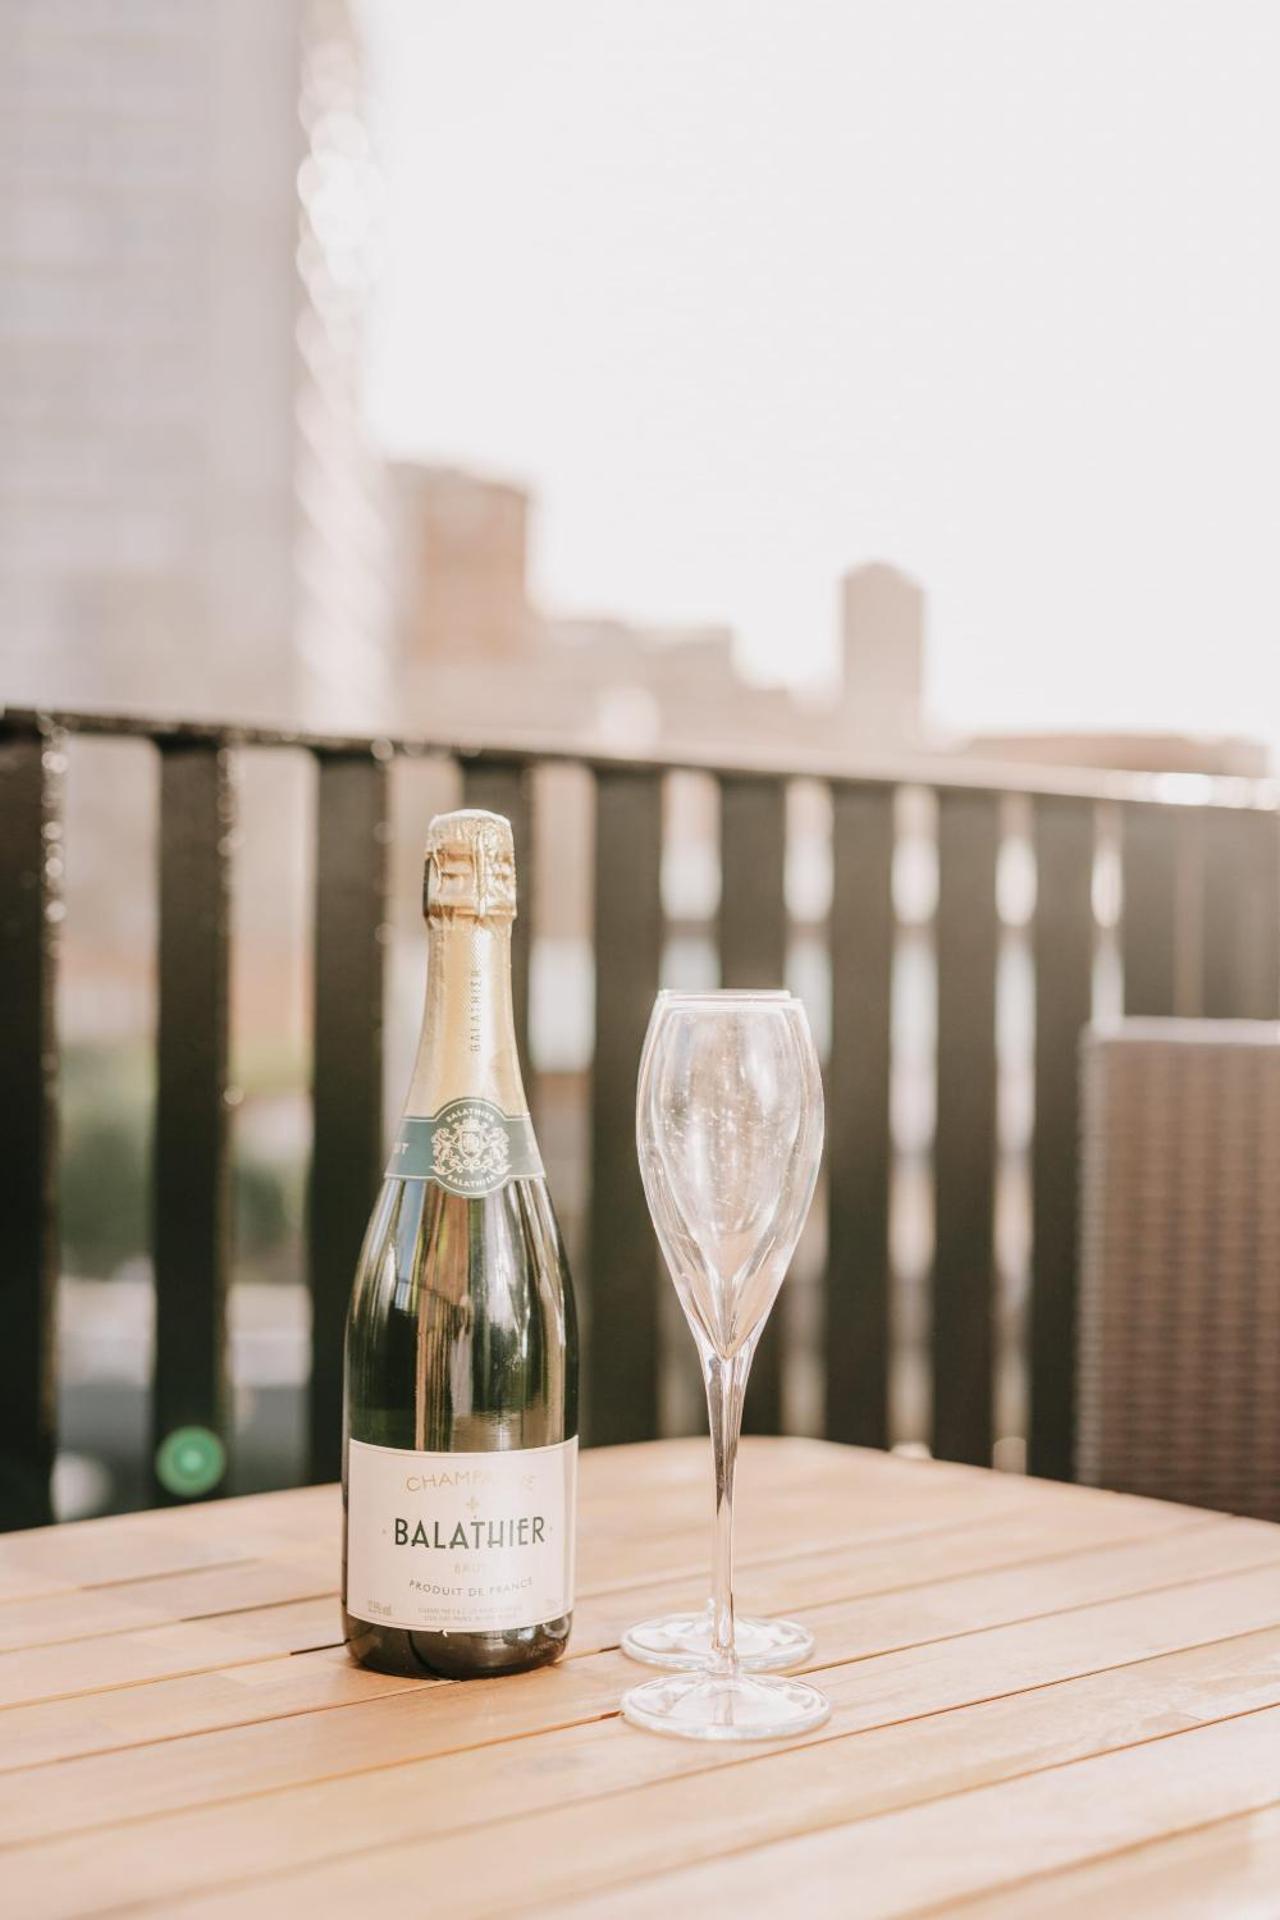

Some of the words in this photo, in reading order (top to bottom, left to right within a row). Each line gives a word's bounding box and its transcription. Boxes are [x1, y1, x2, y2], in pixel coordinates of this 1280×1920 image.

[394, 1516, 545, 1550] BALATHIER
[409, 1578, 464, 1597] PRODUIT
[467, 1587, 484, 1597] DE
[489, 1577, 534, 1595] FRANCE
